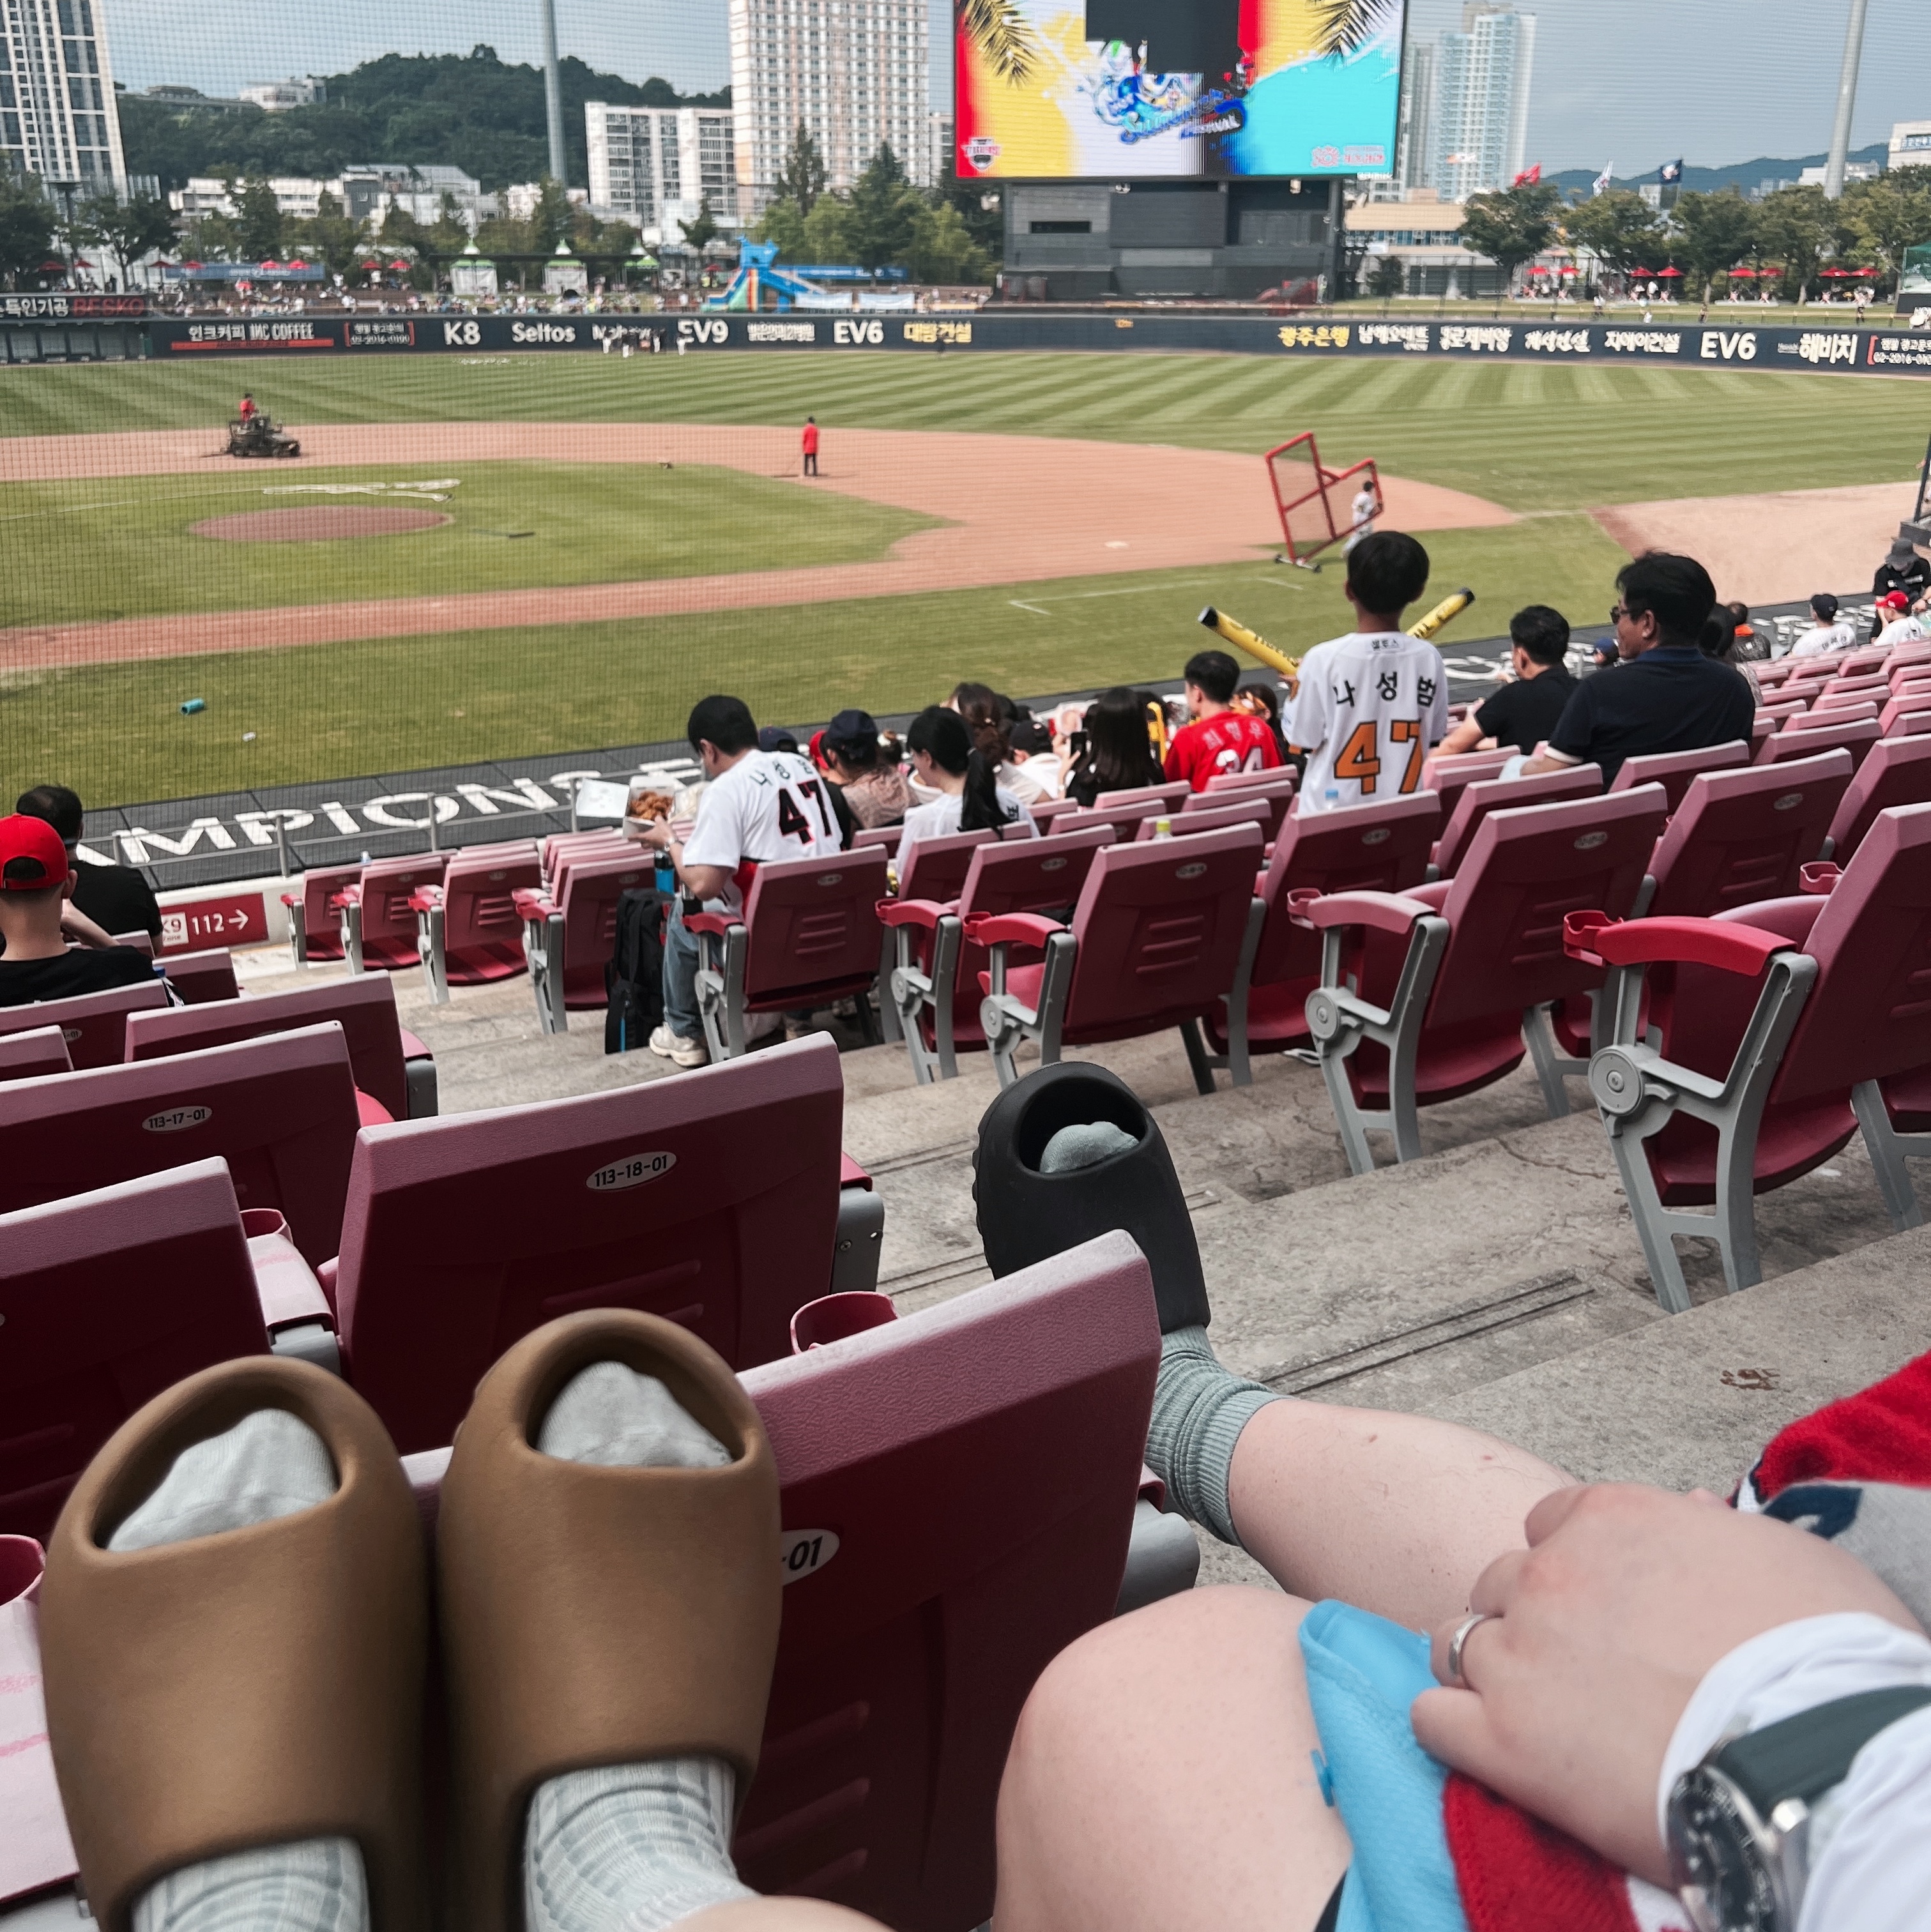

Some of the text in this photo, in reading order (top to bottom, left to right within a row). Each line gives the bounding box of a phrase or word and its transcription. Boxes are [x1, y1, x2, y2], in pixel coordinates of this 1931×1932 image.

[73, 297, 144, 317] BESKO
[188, 323, 245, 342] 인크커피
[270, 321, 314, 340] COFFEE
[443, 320, 481, 346] K8
[510, 321, 576, 343] Seltos
[677, 319, 728, 344] EV9
[832, 319, 883, 344] EV6
[1277, 325, 1349, 347] 광주은행
[1700, 331, 1756, 360] EV6
[1798, 333, 1858, 365] 해비치
[1332, 671, 1436, 708] 나성범
[1334, 720, 1422, 795] 47
[778, 779, 831, 846] 47
[192, 913, 224, 935] 112
[148, 1109, 206, 1129] 113-17-01
[594, 1154, 666, 1187] 113-18-01
